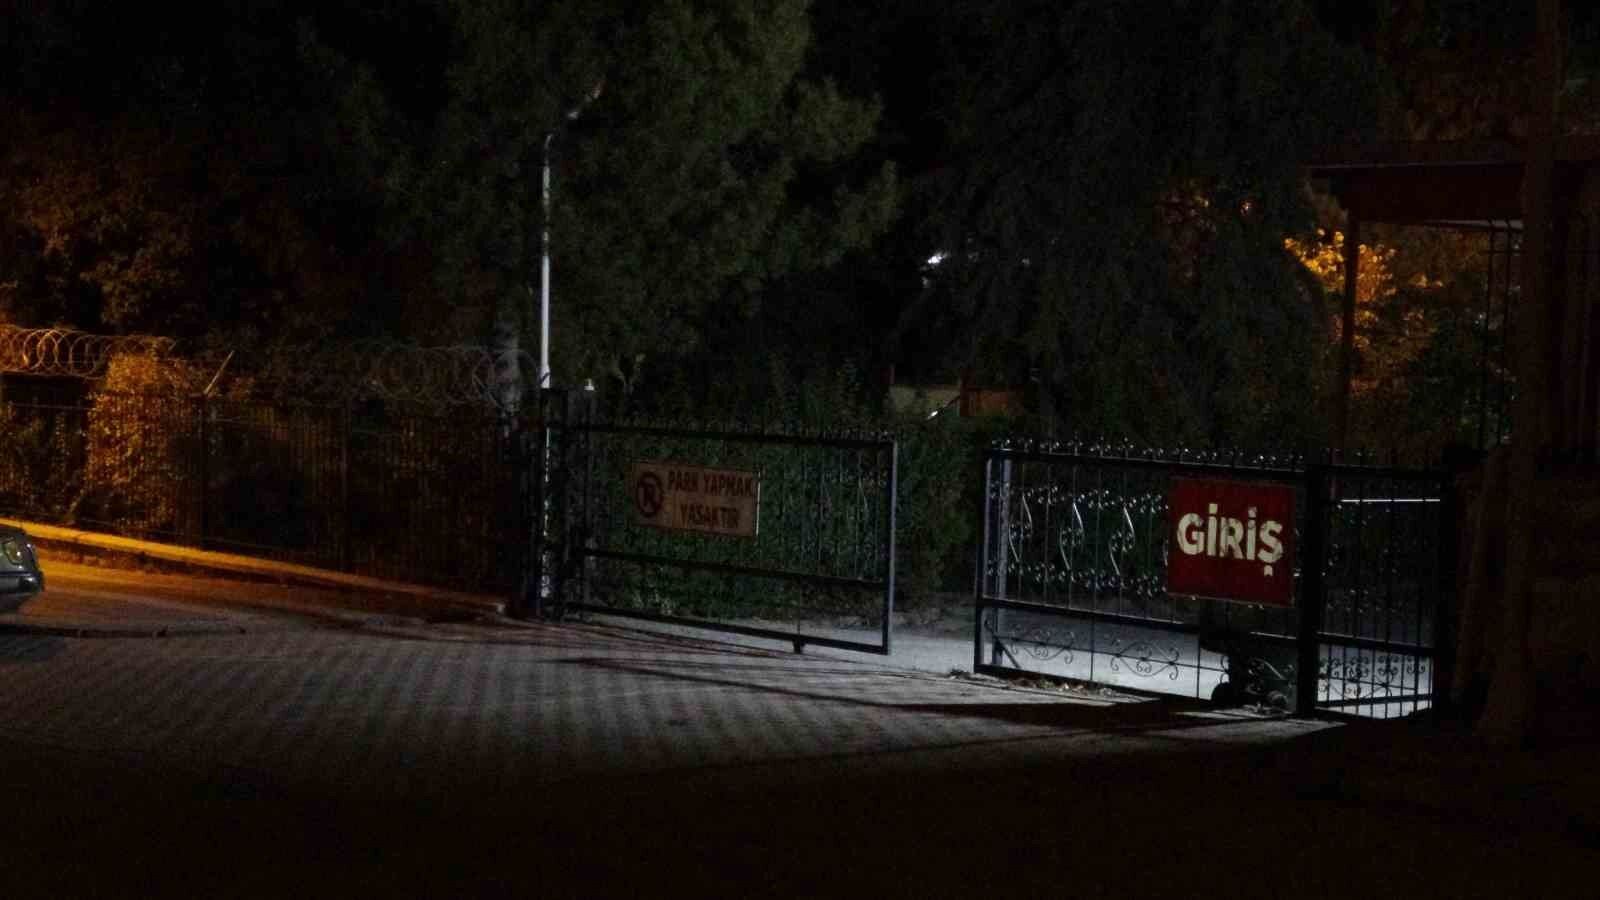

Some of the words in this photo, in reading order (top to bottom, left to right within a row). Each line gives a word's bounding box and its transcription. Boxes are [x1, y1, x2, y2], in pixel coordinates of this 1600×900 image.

[669, 470, 699, 493] PARK
[703, 473, 753, 497] YAPMAK
[1177, 502, 1284, 577] GİRİŞ
